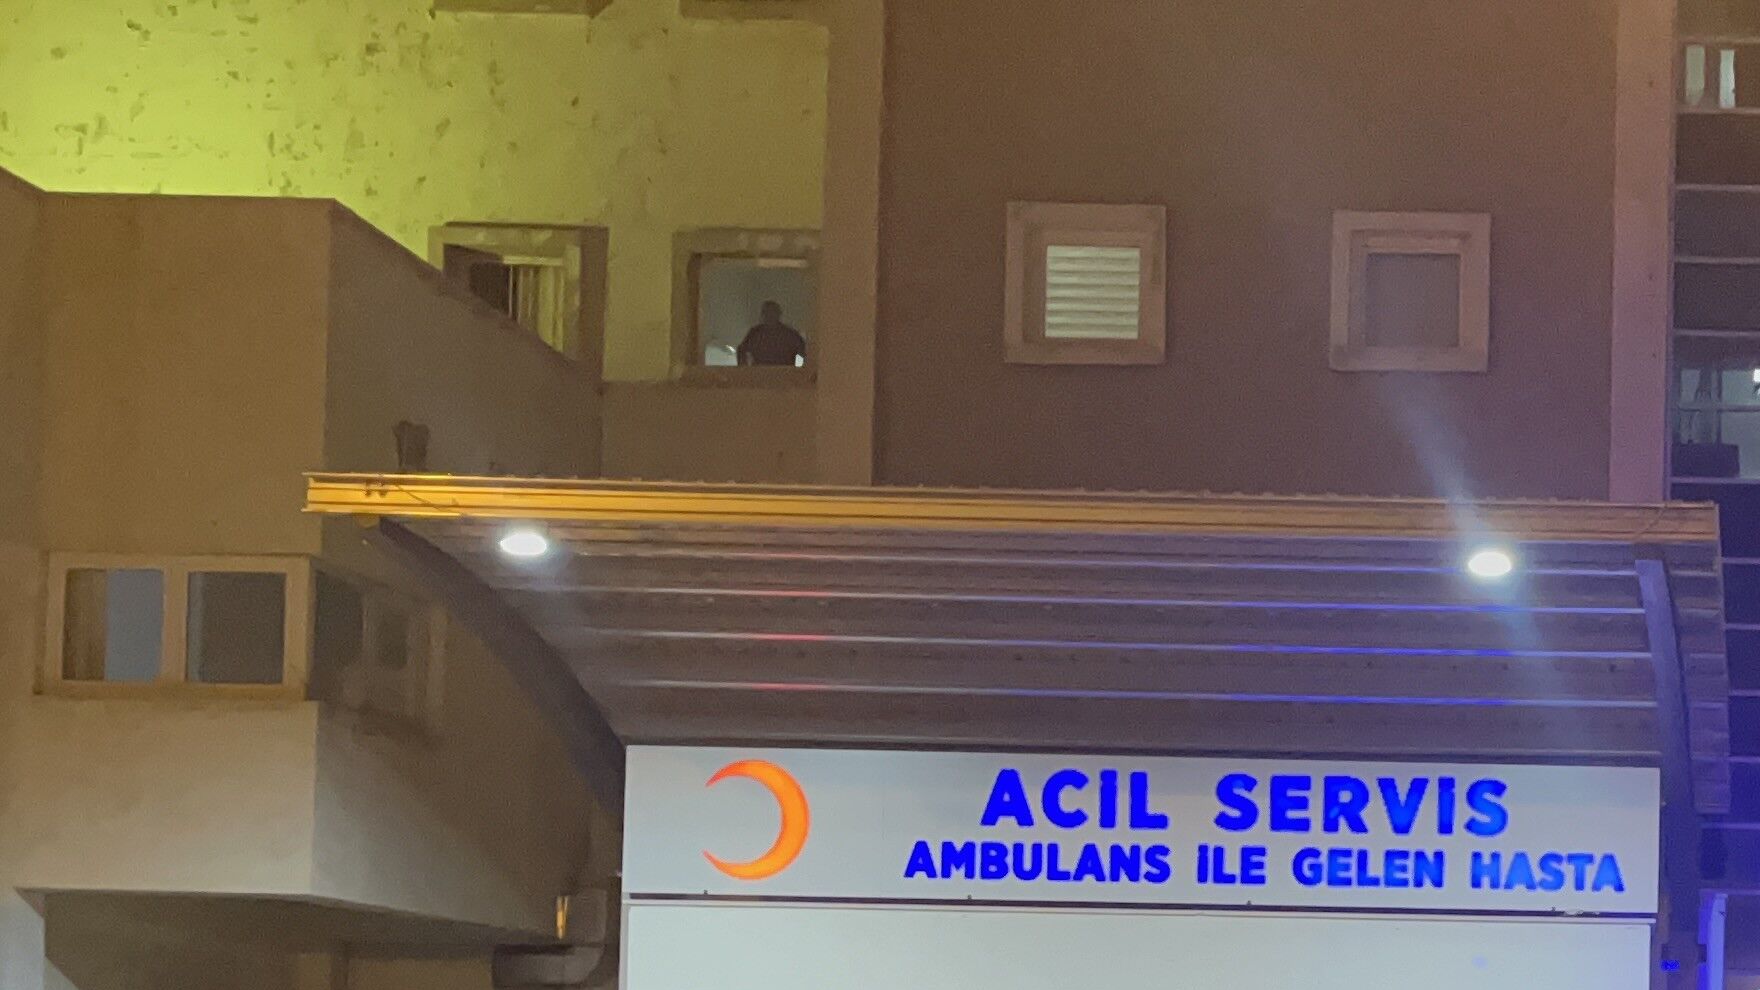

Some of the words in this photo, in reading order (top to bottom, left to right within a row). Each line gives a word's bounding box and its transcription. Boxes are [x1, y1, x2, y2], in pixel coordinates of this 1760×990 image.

[904, 840, 1172, 884] AMBULANS
[1292, 847, 1446, 889] GELEN
[1470, 850, 1626, 894] HASTA
